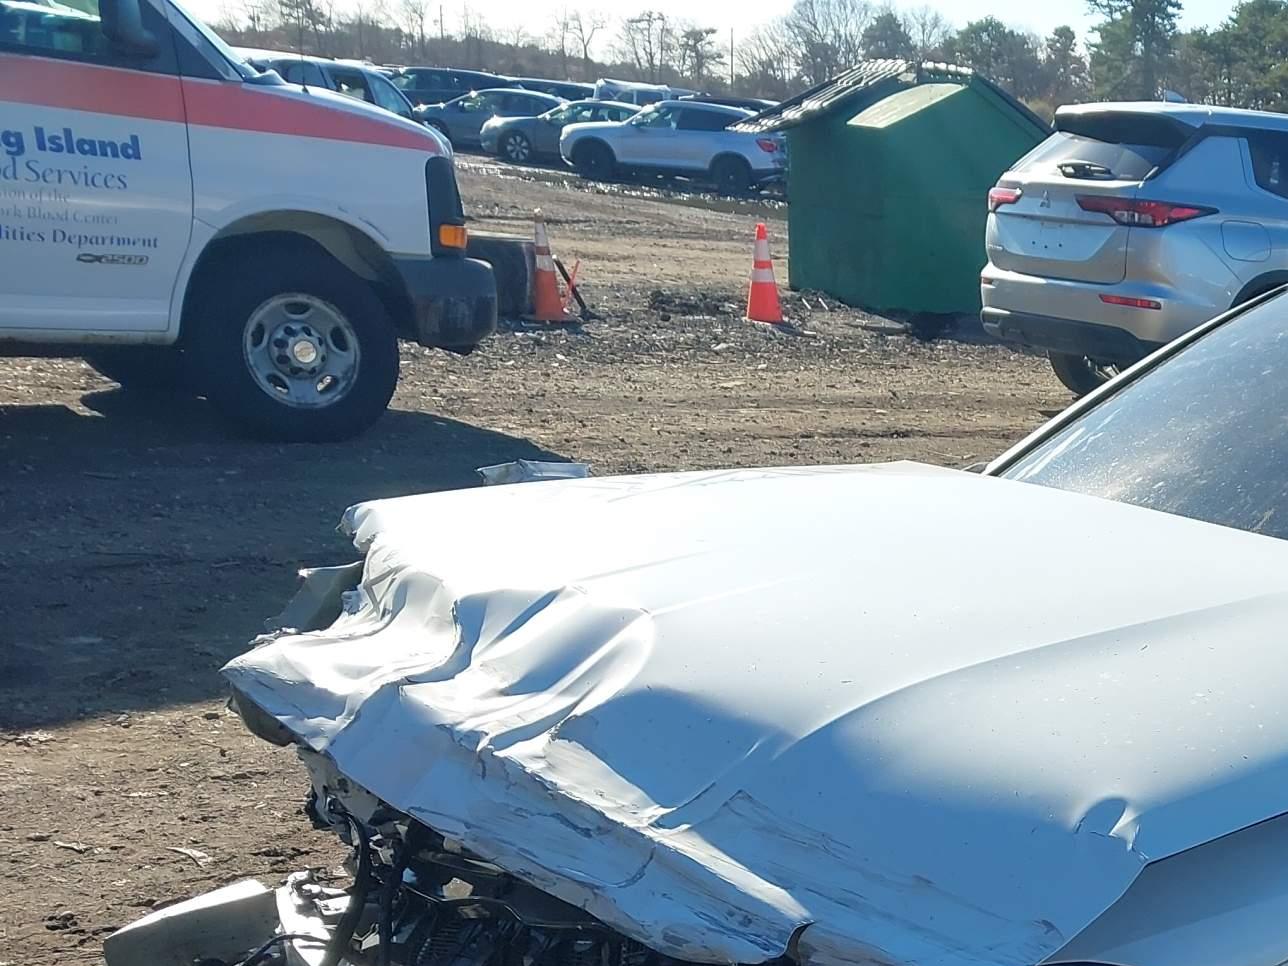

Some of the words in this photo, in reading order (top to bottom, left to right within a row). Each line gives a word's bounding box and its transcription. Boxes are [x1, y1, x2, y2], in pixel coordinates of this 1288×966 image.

[34, 126, 141, 160] Island
[25, 159, 127, 189] Services
[52, 228, 158, 248] Department
